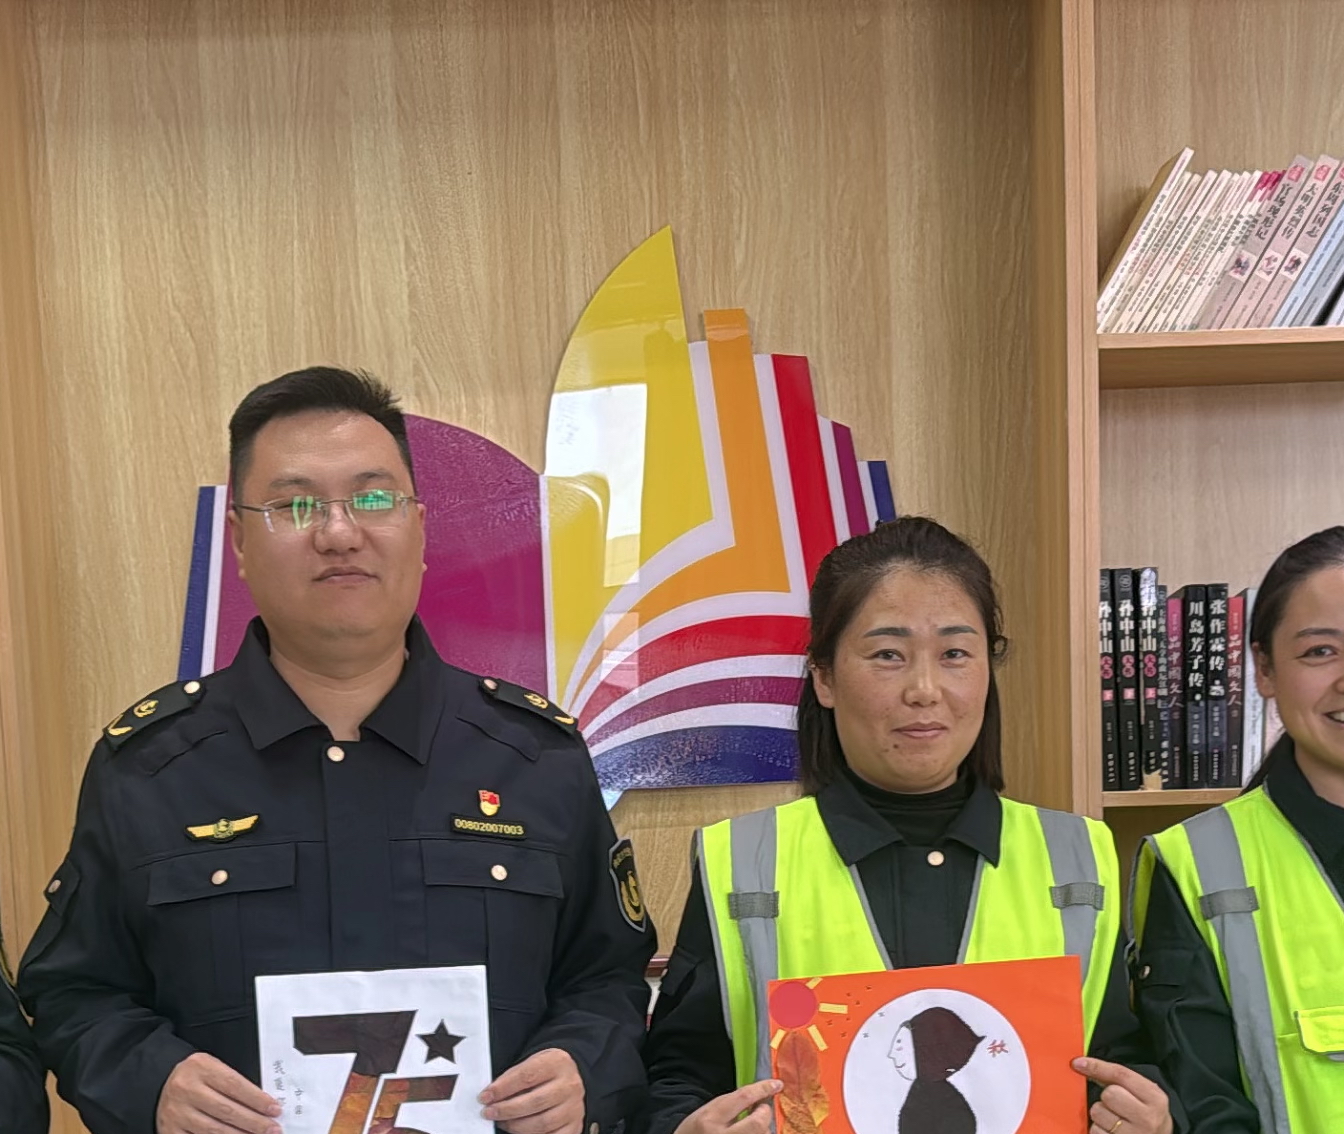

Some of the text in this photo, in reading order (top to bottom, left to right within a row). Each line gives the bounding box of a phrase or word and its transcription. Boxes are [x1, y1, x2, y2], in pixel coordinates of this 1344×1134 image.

[1118, 599, 1136, 653] 孙中山
[1188, 601, 1206, 688] 川岛芳子传
[1208, 599, 1227, 671] 张作霖传
